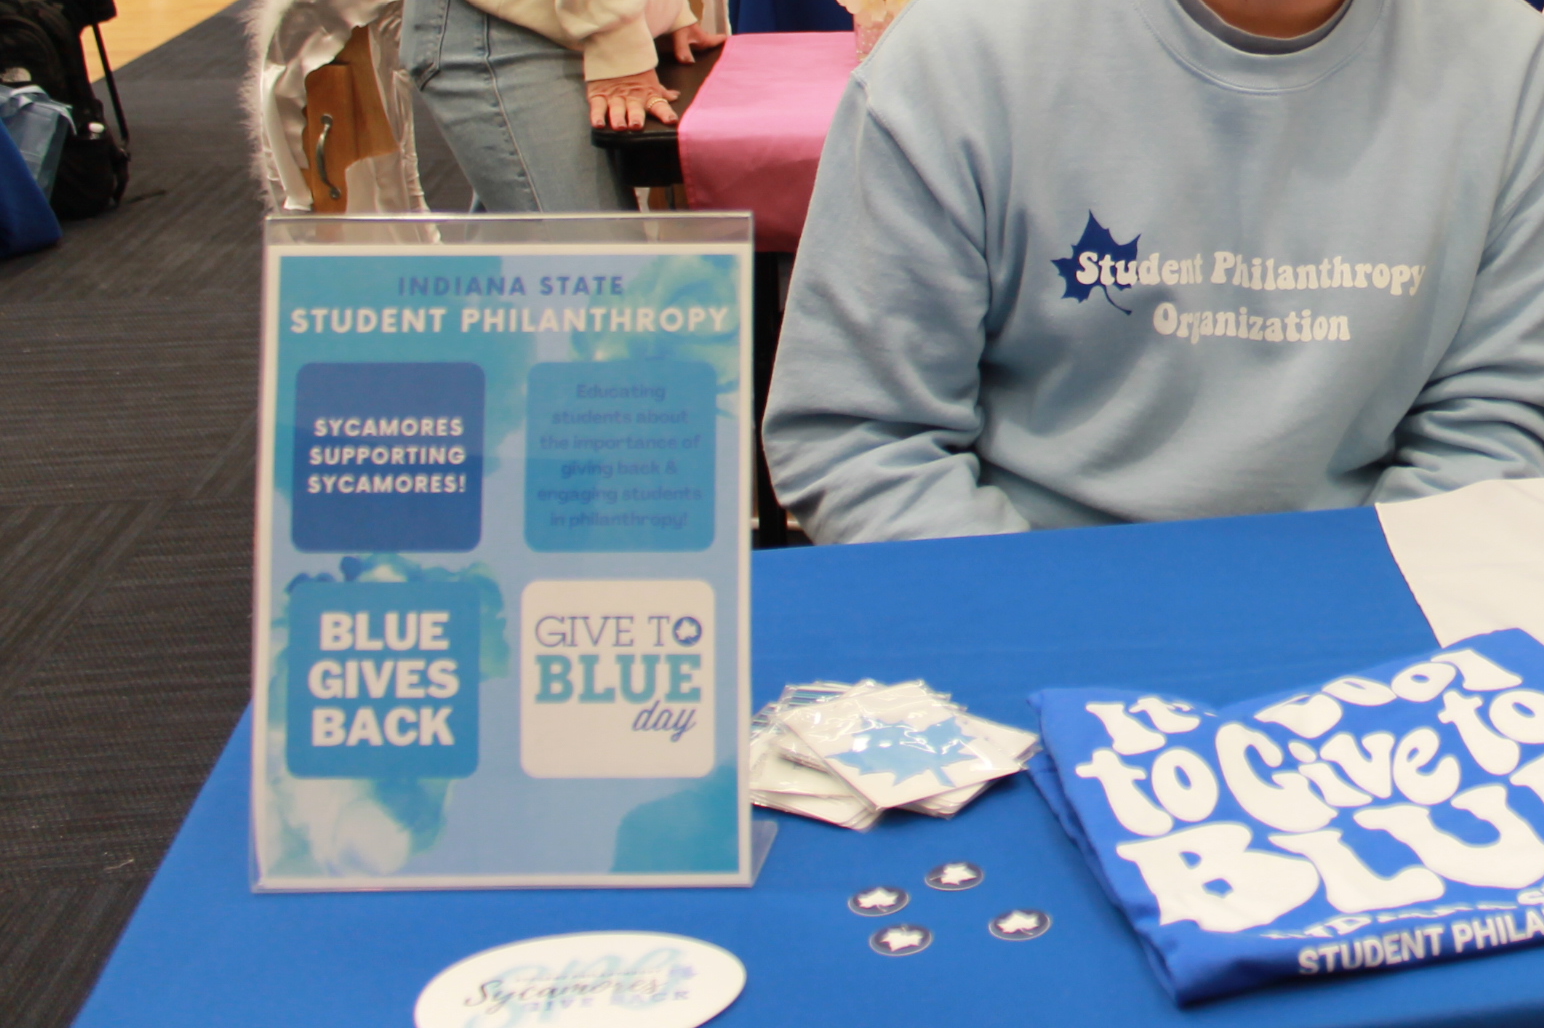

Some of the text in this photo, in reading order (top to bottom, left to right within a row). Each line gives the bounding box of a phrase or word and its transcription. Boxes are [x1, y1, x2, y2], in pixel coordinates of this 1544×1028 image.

[398, 275, 625, 297] INDIANA STATE
[1075, 250, 1426, 296] Student Philanthropy
[290, 306, 730, 334] STUDENT PHILANTHROPY
[576, 383, 666, 402] Educating
[313, 416, 463, 438] SYCAMORES
[551, 409, 689, 425] students about
[308, 445, 466, 466] SUPPORTING
[539, 433, 701, 454] the importance of
[560, 458, 678, 478] giving back &
[307, 473, 467, 495] SYCAMORES!
[536, 484, 703, 505] engaging students
[551, 510, 688, 531] in philanthropy!
[319, 610, 450, 652] BLUE
[535, 615, 703, 648] GIVE TO
[308, 658, 460, 700] GIVES
[534, 653, 703, 705] BLUE
[311, 706, 455, 747] BACK
[632, 699, 697, 743] day
[1076, 746, 1219, 837] to
[1214, 720, 1461, 834] Give
[1298, 927, 1445, 976] STUDENT
[463, 977, 660, 1014] Sycamores
